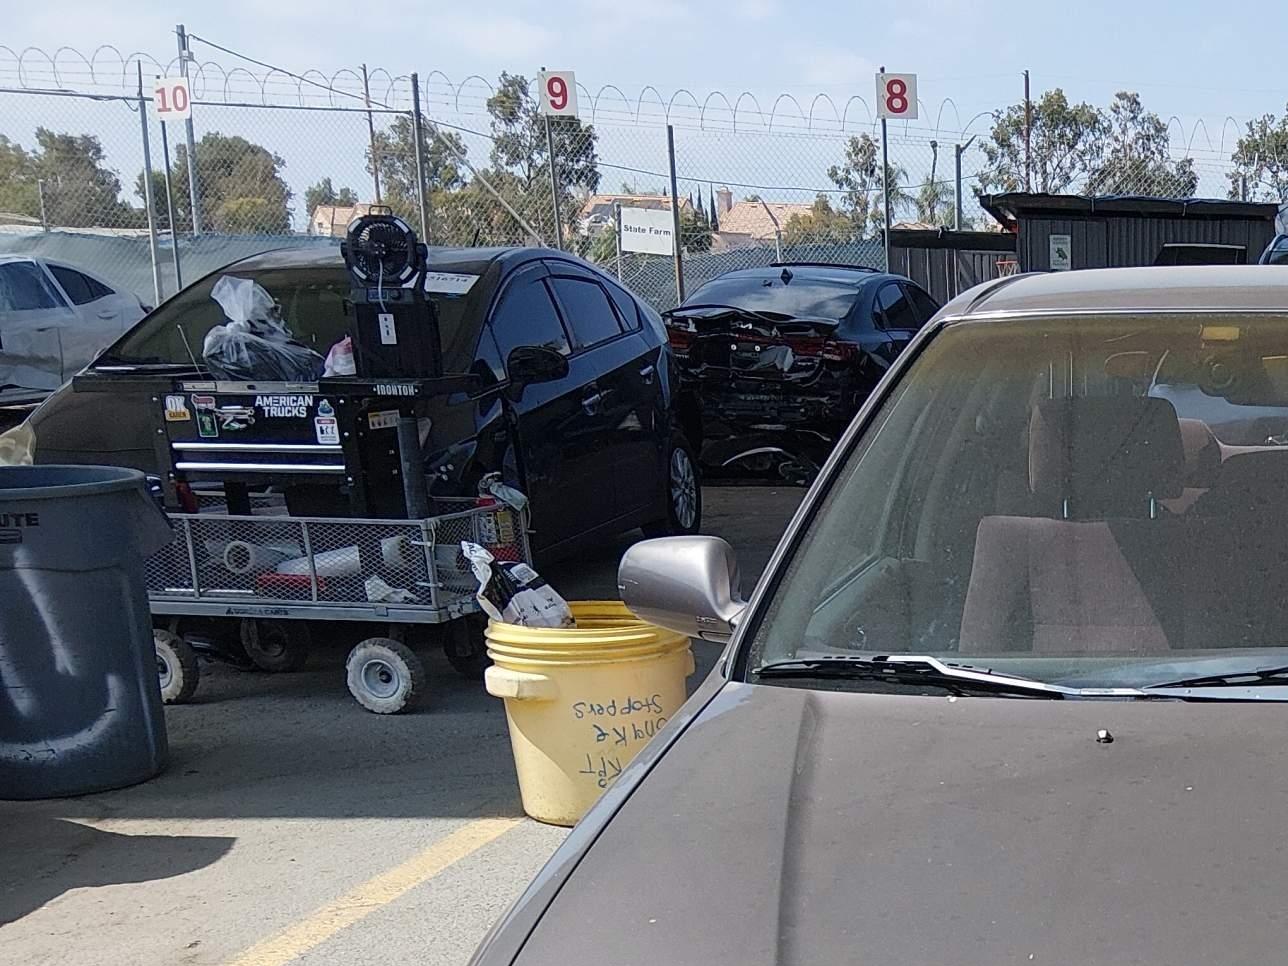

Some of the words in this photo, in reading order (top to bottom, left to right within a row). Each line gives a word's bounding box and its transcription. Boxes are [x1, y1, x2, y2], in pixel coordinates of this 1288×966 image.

[155, 85, 188, 113] 10
[546, 76, 569, 111] 9
[885, 78, 909, 114] 8
[623, 224, 647, 234] State
[649, 226, 671, 237] Farm
[255, 395, 314, 407] AMERICAN
[262, 406, 307, 418] TRUCKS
